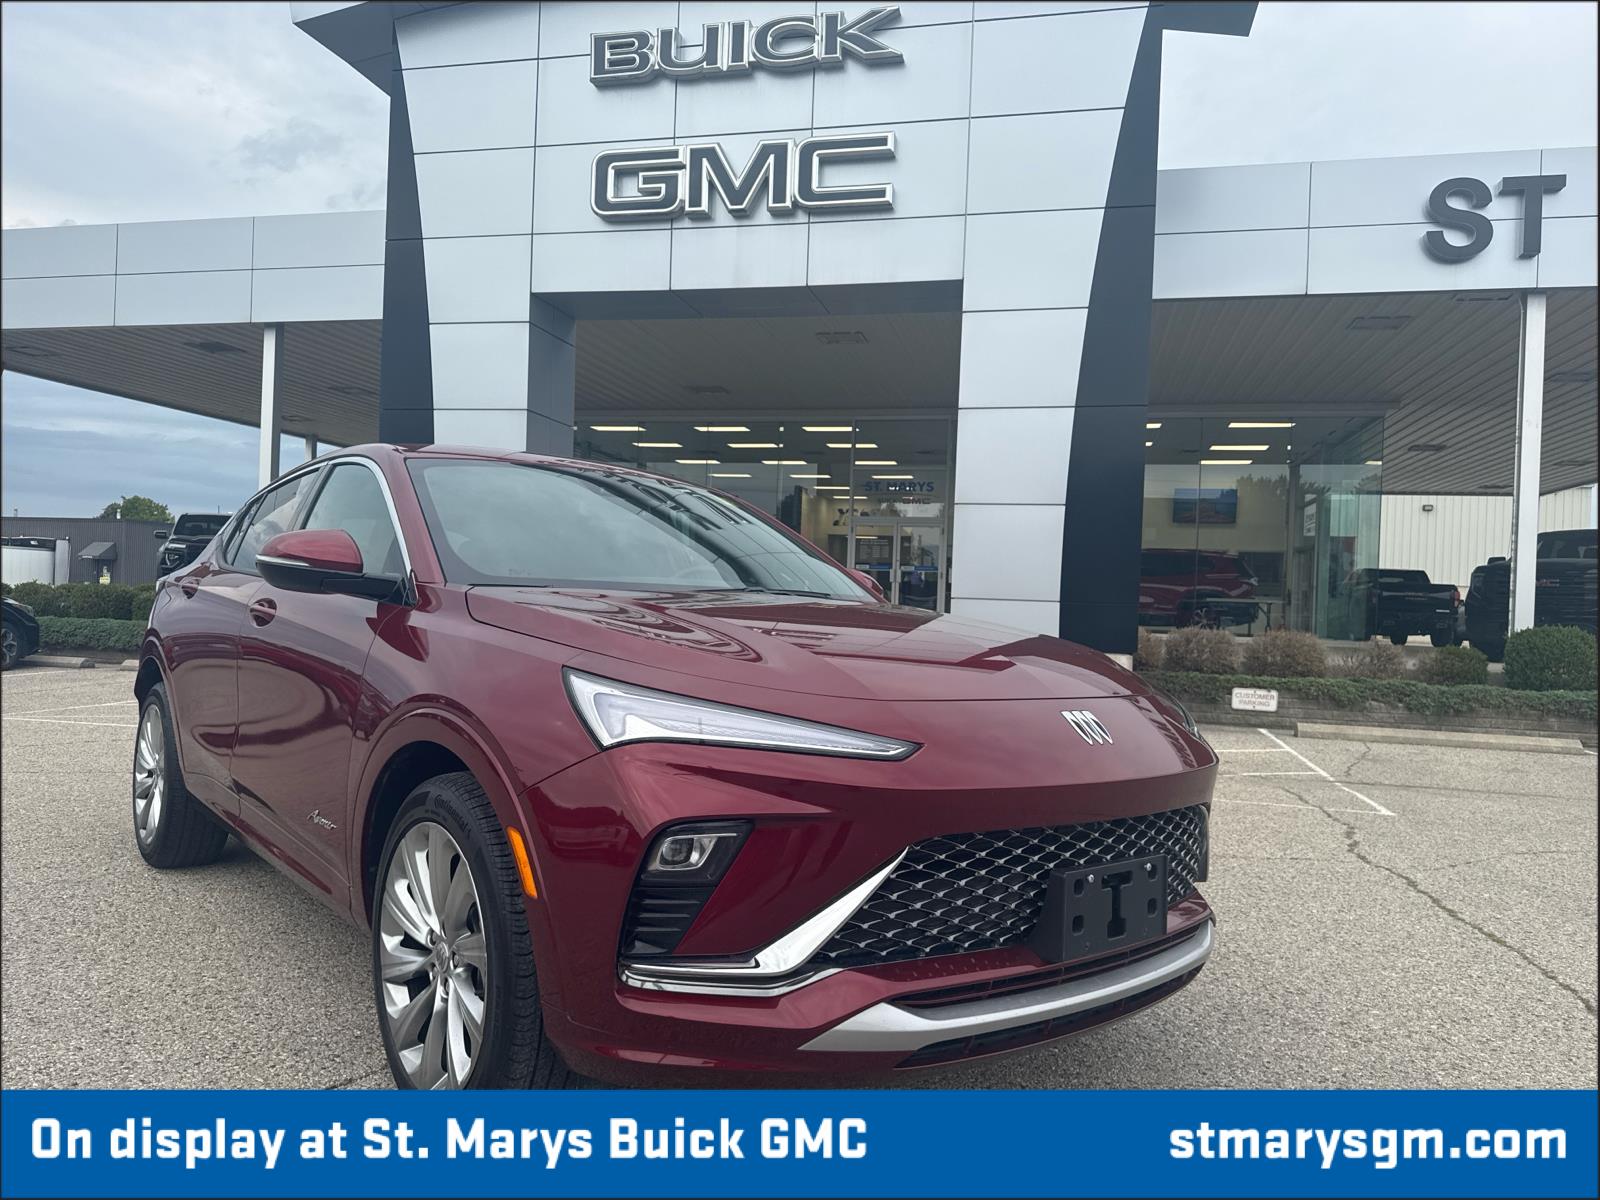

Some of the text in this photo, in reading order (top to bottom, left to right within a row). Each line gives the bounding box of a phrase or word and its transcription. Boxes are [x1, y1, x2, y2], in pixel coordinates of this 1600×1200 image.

[590, 5, 904, 87] BUICK
[591, 131, 896, 222] GMC
[1419, 174, 1567, 264] ST
[886, 481, 935, 493] MARYS
[1234, 691, 1275, 701] CUSTOMER
[1238, 699, 1271, 707] PARKING
